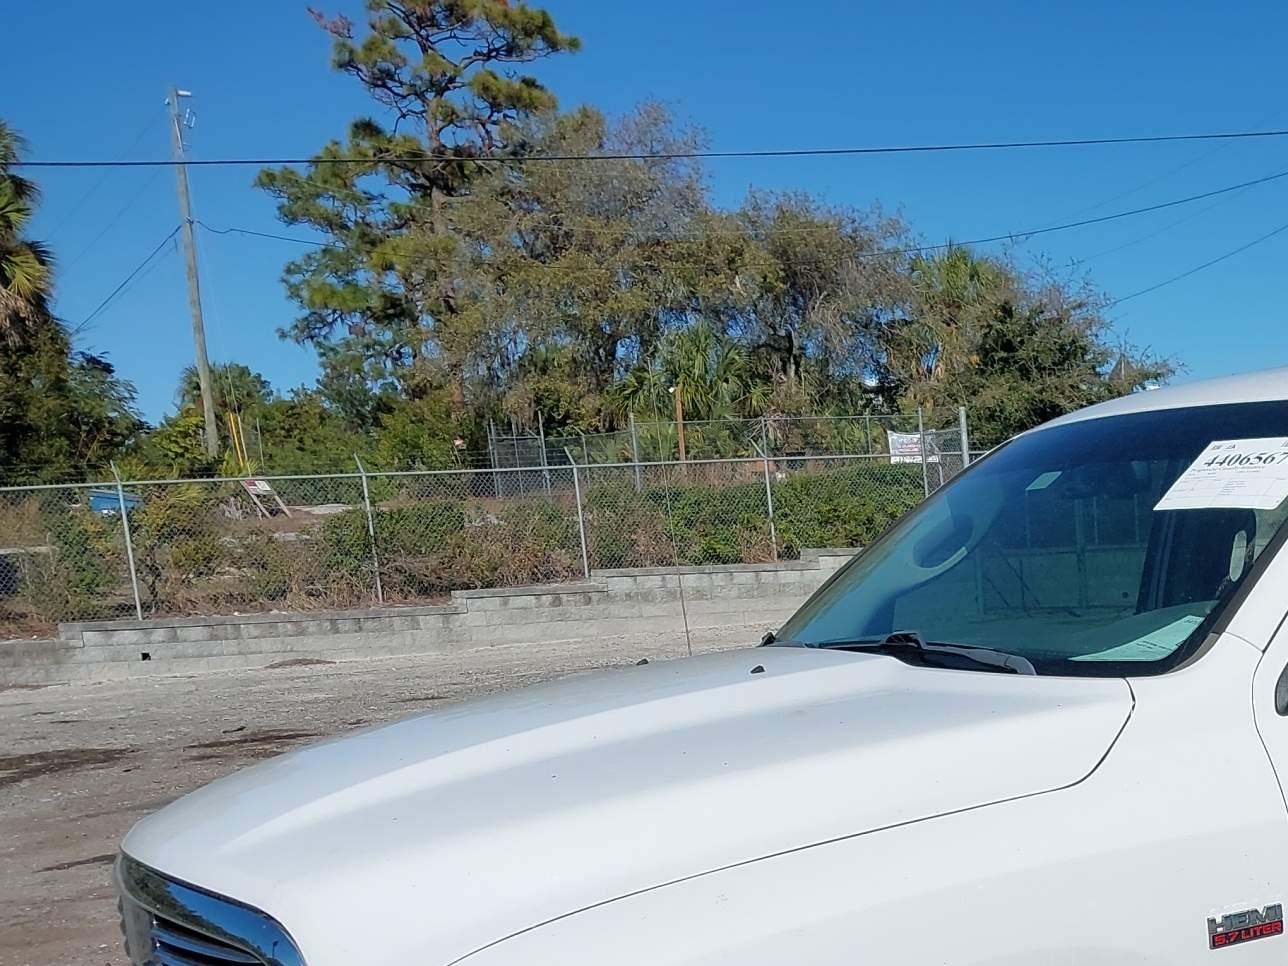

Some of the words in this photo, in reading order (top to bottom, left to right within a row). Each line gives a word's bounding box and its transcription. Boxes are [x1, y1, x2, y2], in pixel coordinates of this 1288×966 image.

[1207, 903, 1283, 934] HEMI
[1215, 931, 1239, 945] 5.7
[1241, 921, 1282, 941] LITER
